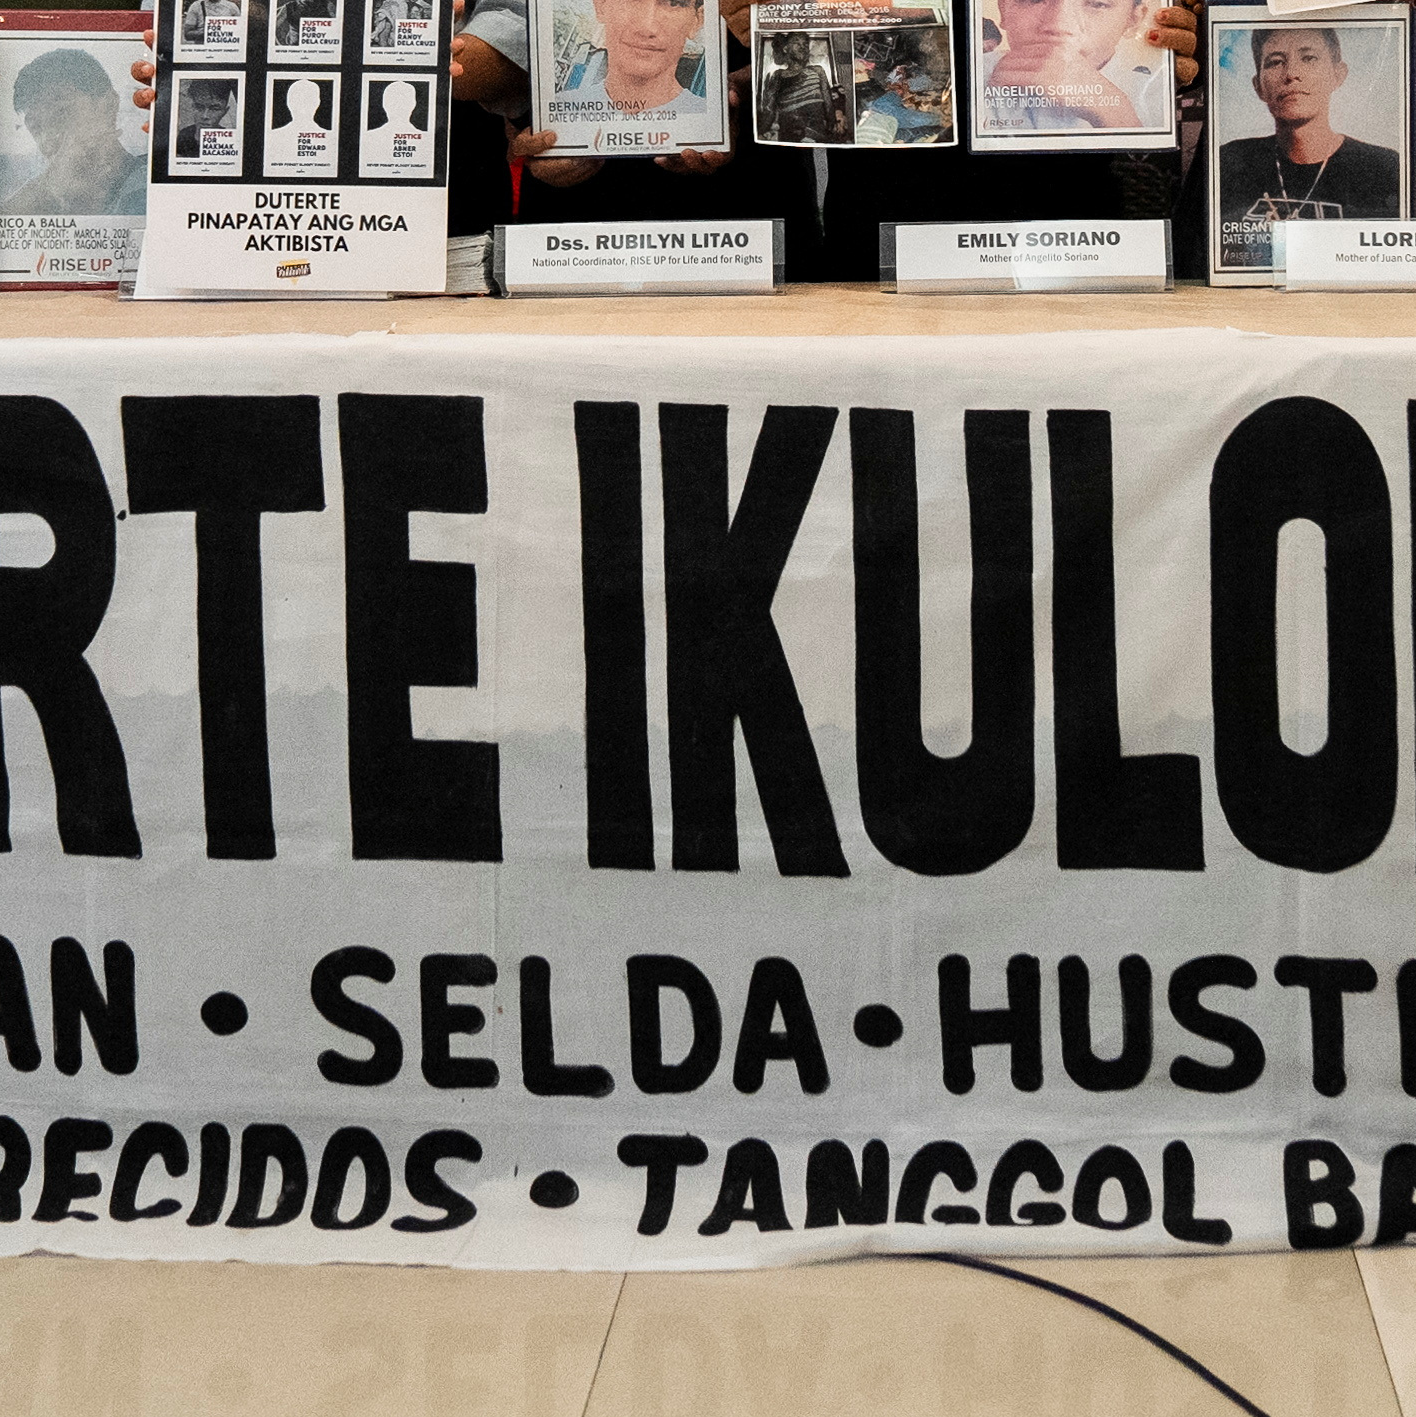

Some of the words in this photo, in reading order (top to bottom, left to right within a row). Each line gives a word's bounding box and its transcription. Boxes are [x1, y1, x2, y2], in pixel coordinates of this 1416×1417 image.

[805, 1, 861, 9] ESPINOSA
[985, 85, 1044, 97] ANGELITO
[1048, 85, 1103, 95] SORIANO
[549, 102, 603, 111] BERNARD
[607, 100, 647, 110] NONAY
[607, 133, 644, 146] RISE
[648, 132, 670, 144] UP
[255, 193, 340, 210] DUTERTE
[28, 219, 36, 227] A
[41, 219, 76, 228] BALLA
[188, 213, 300, 230] PINAPATAY
[308, 215, 354, 231] ANG
[359, 216, 408, 231] MGA
[245, 235, 348, 252] AKTIBISTA
[546, 236, 589, 250] Dss.
[596, 234, 685, 249] RUBILYN
[692, 233, 748, 248] LITAO
[957, 233, 1020, 248] EMILY
[1026, 231, 1120, 246] SORIANO
[532, 258, 570, 267] National
[572, 257, 628, 267] Coordinator,
[630, 256, 651, 264] RISE
[654, 256, 666, 264] UP
[668, 256, 680, 264] for
[683, 255, 698, 264] Life
[701, 256, 718, 264] and
[720, 255, 732, 263] for
[735, 255, 763, 264] Rights
[980, 254, 1011, 263] Mother
[1014, 254, 1023, 262] of
[1025, 253, 1062, 264] Angelito
[1064, 253, 1099, 261] Soriano
[1336, 253, 1368, 262] Mother
[1370, 254, 1379, 262] of
[1381, 254, 1403, 263] Juan
[50, 259, 86, 271] RISE
[91, 259, 112, 271] UP
[313, 949, 822, 1099] SELDA
[620, 1131, 1232, 1245] TANGGOL
